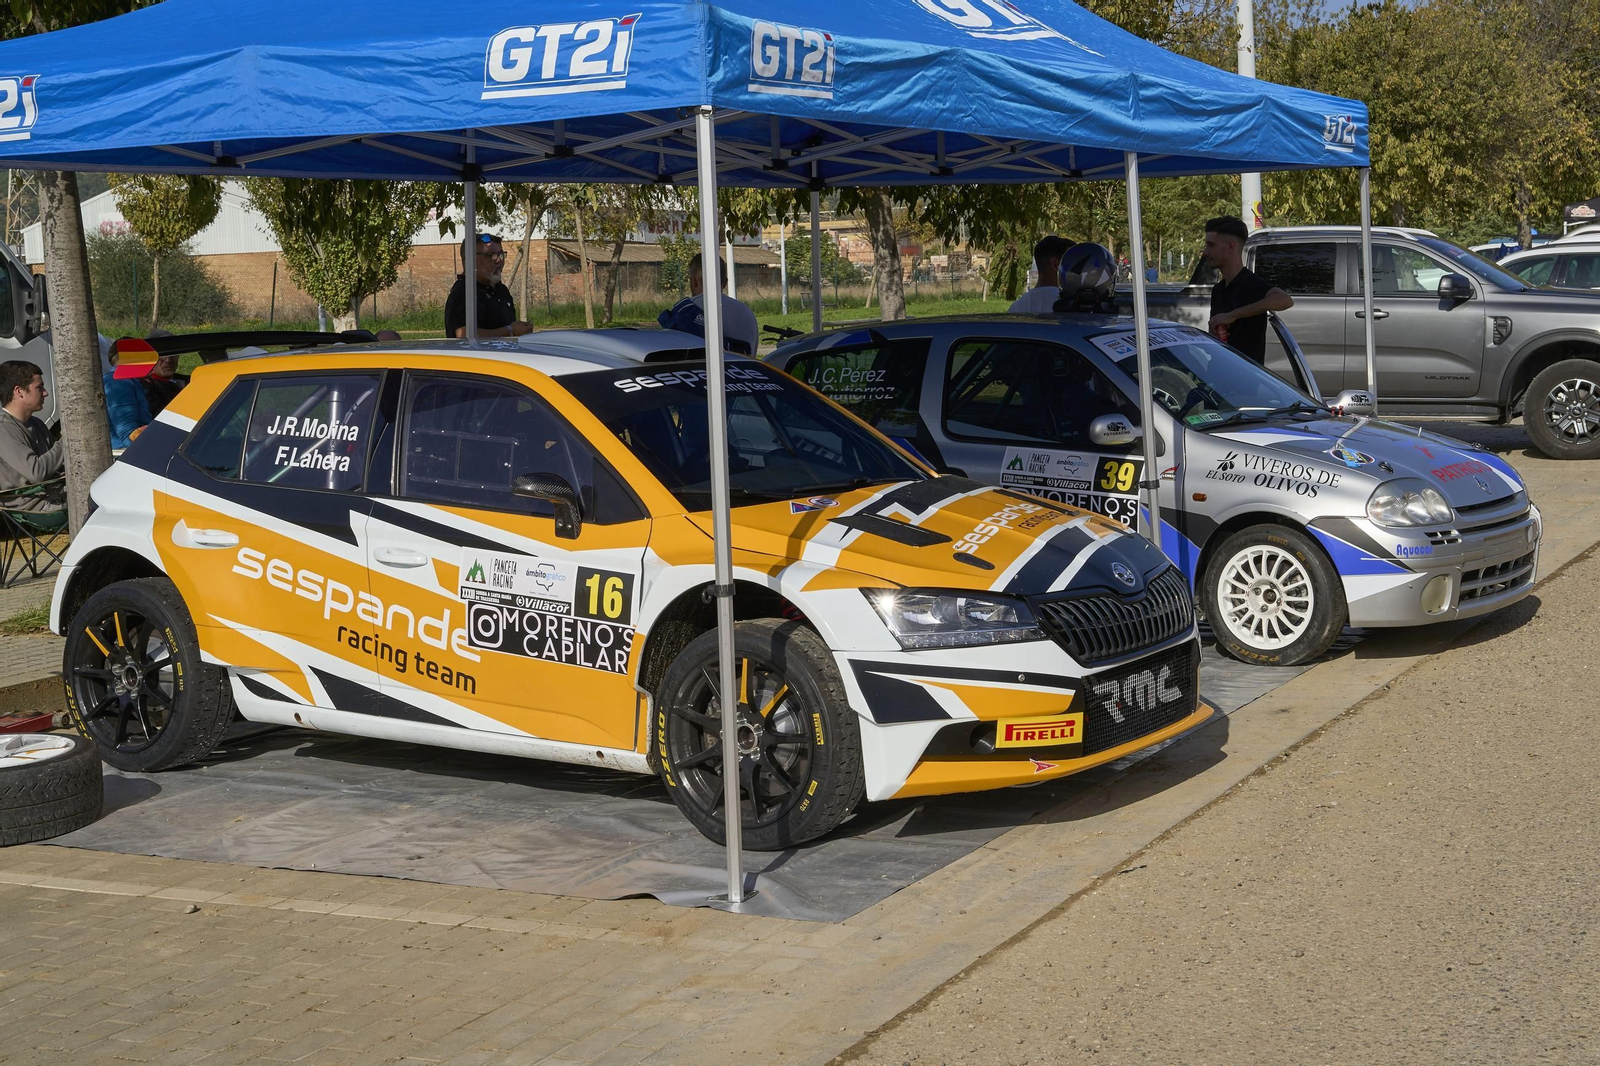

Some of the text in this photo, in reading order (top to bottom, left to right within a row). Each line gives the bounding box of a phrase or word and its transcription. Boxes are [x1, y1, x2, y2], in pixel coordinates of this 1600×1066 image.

[488, 17, 635, 83] GT2i
[752, 20, 834, 84] GT2i
[266, 415, 359, 441] J.R.Molina
[274, 446, 351, 472] F.Lahera
[1100, 460, 1136, 492] 39
[1243, 453, 1342, 489] VIVEROS DE
[1205, 469, 1246, 484] EL SOTO
[1253, 473, 1320, 499] OLIVOS
[492, 572, 514, 590] RACING
[494, 558, 518, 576] PANCETA
[231, 546, 482, 664] sespande
[525, 597, 570, 614] Villacor
[585, 573, 624, 619] 16
[503, 606, 636, 653] MORENO'S
[337, 625, 477, 696] racing team
[523, 633, 628, 674] CAPILAR
[658, 711, 671, 773] ZERO
[1004, 719, 1076, 742] PIRELLI
